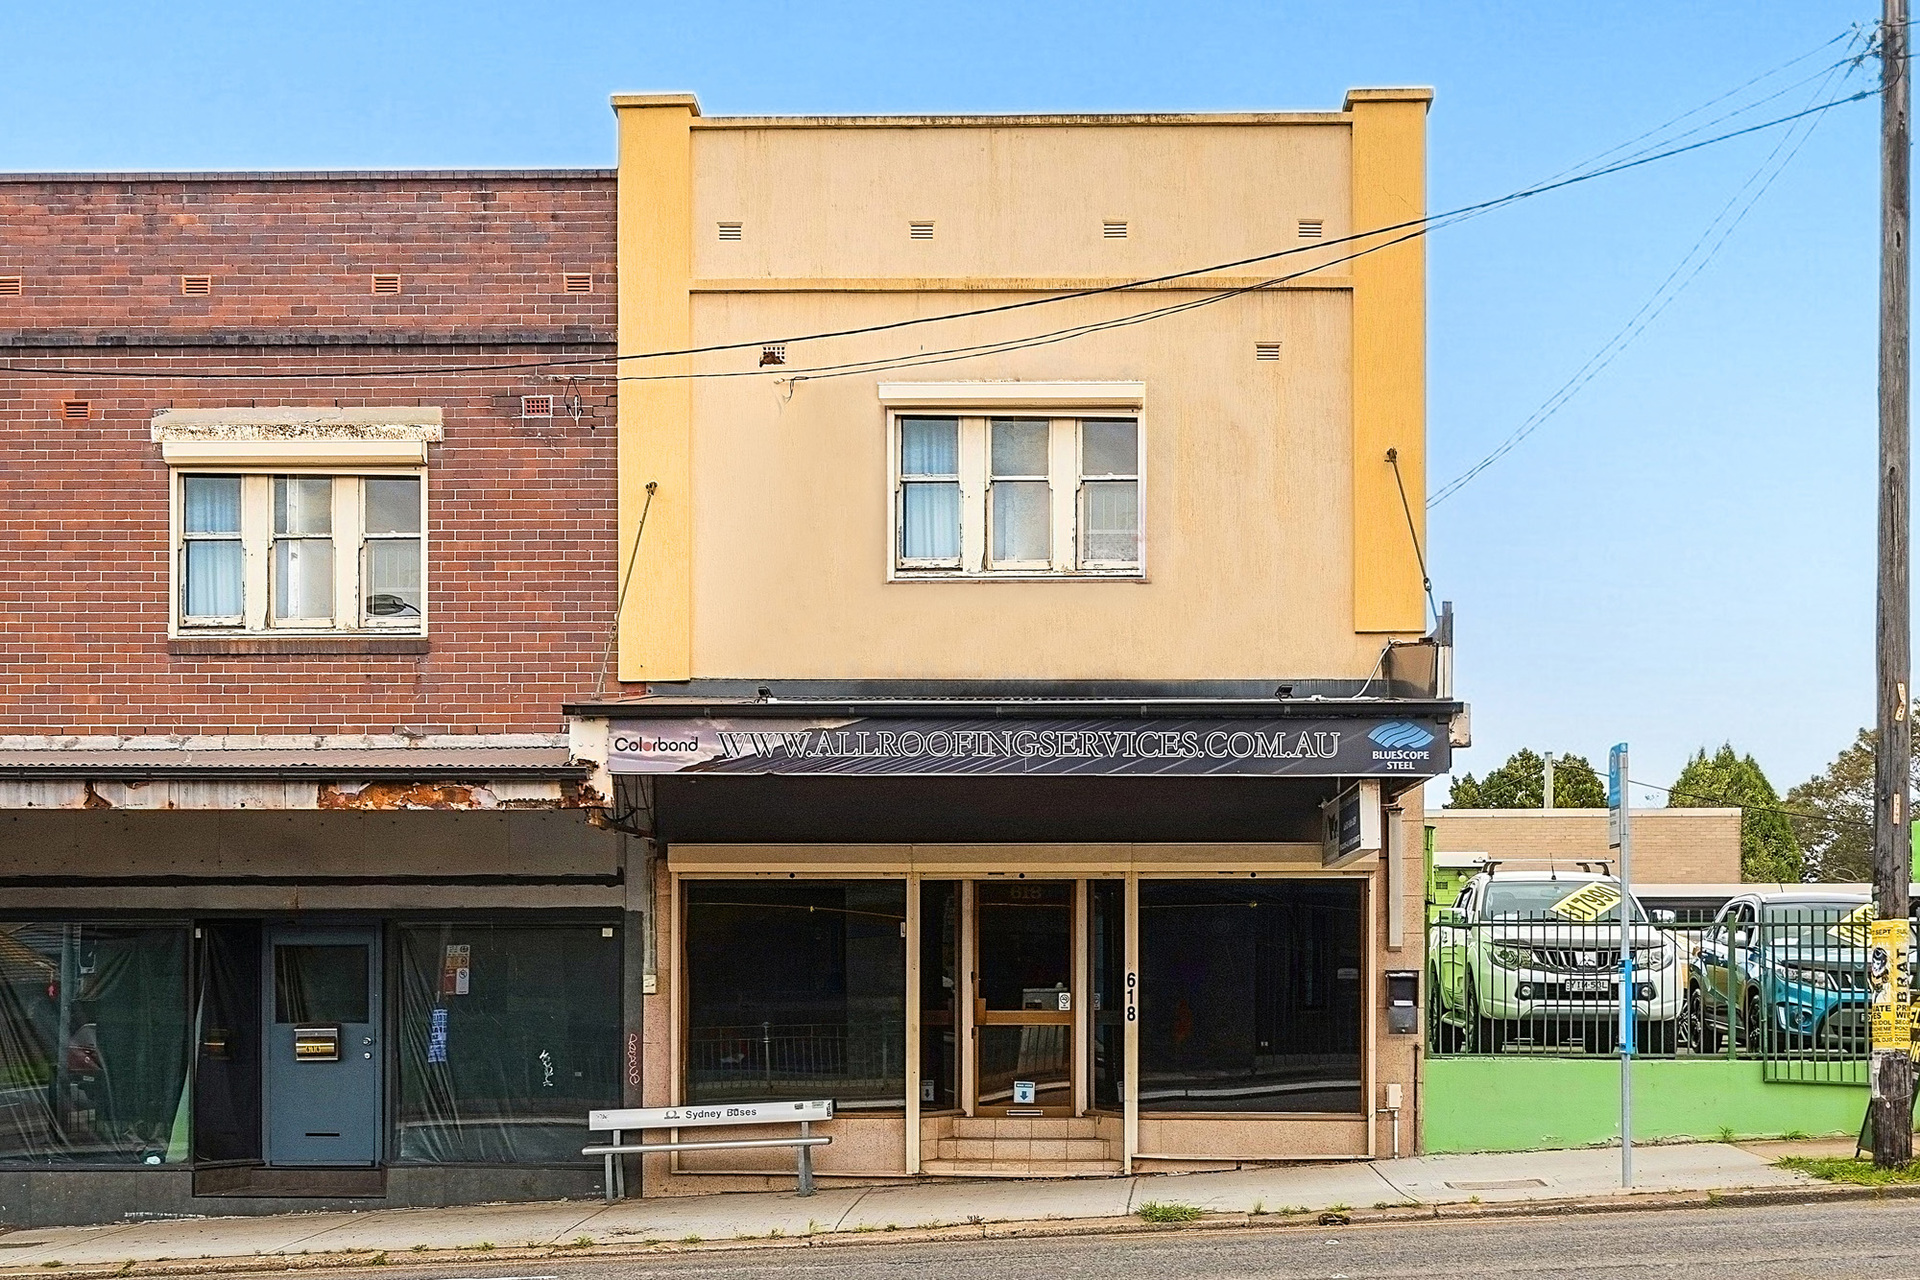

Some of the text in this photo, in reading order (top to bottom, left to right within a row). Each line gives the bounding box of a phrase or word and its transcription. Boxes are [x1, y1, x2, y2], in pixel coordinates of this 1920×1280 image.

[716, 730, 1340, 759] WWW.ALLROOFINGSERVICES.COM.AU
[1372, 750, 1430, 760] BLUESCOPE
[1386, 761, 1415, 770] STEEL
[1896, 948, 1909, 1002] BRAT
[1126, 972, 1136, 1021] 618
[685, 1109, 722, 1120] Sydney
